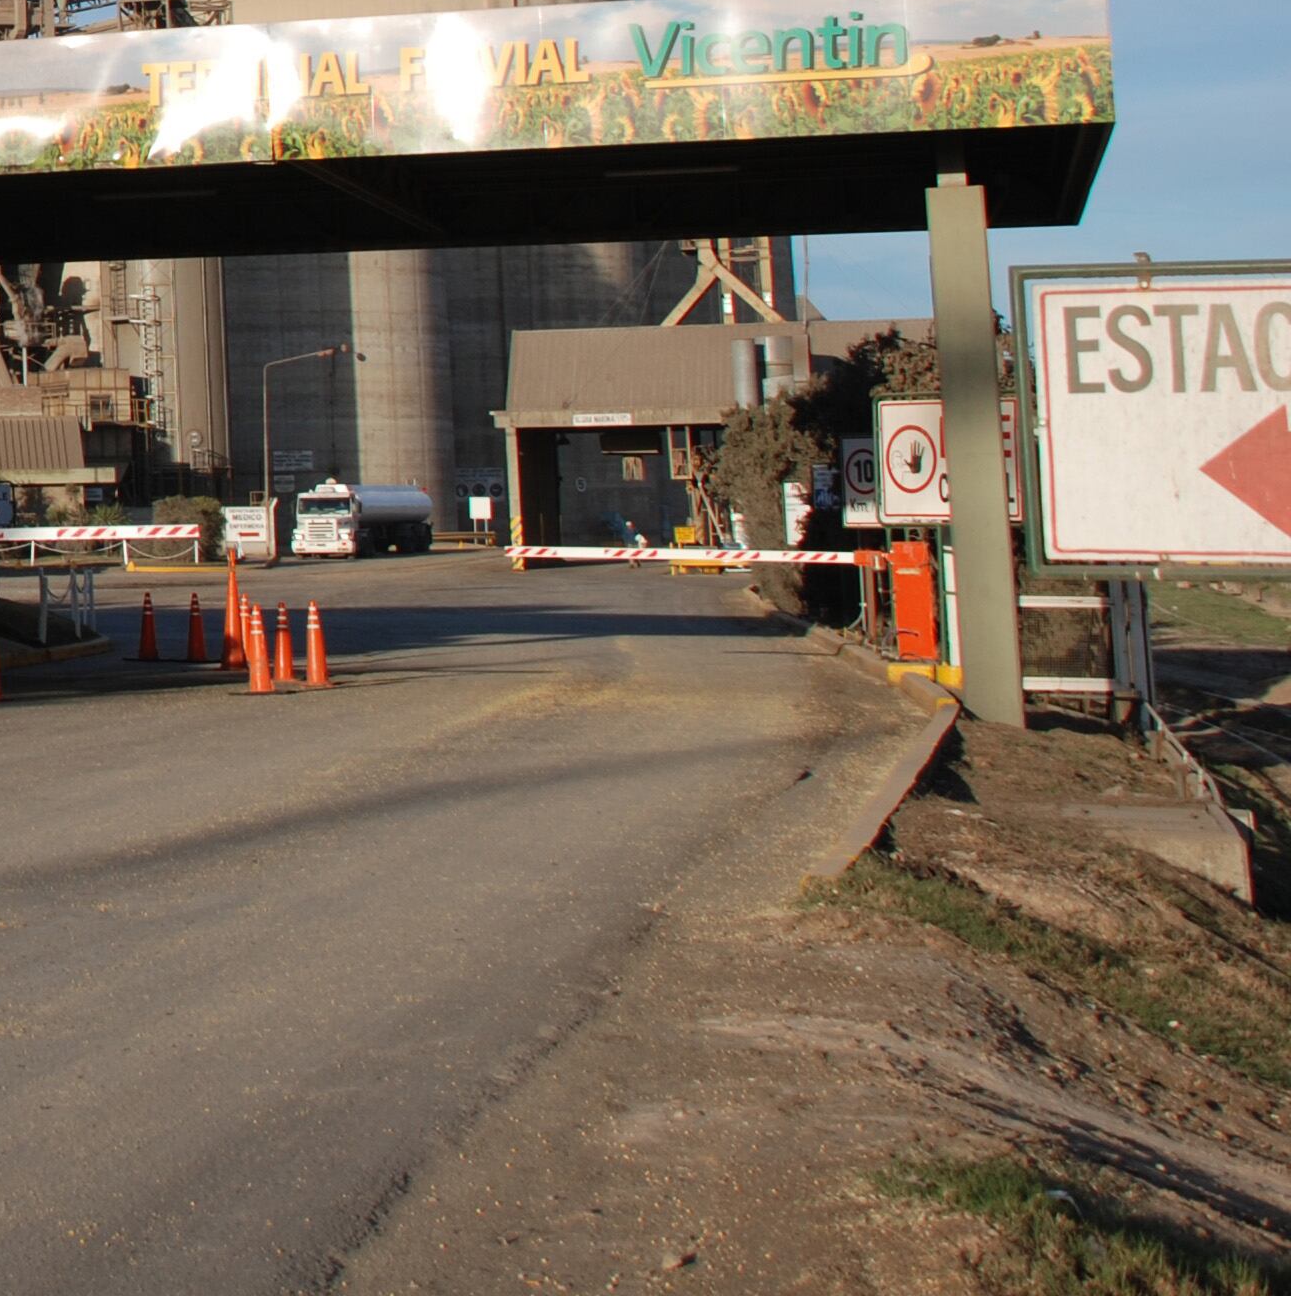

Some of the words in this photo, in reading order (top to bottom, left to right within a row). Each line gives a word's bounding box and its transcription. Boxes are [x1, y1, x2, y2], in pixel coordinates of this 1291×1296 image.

[141, 52, 371, 106] TERAL
[399, 37, 591, 92] FVIAL
[628, 11, 908, 78] Vicentin
[853, 460, 874, 483] 10
